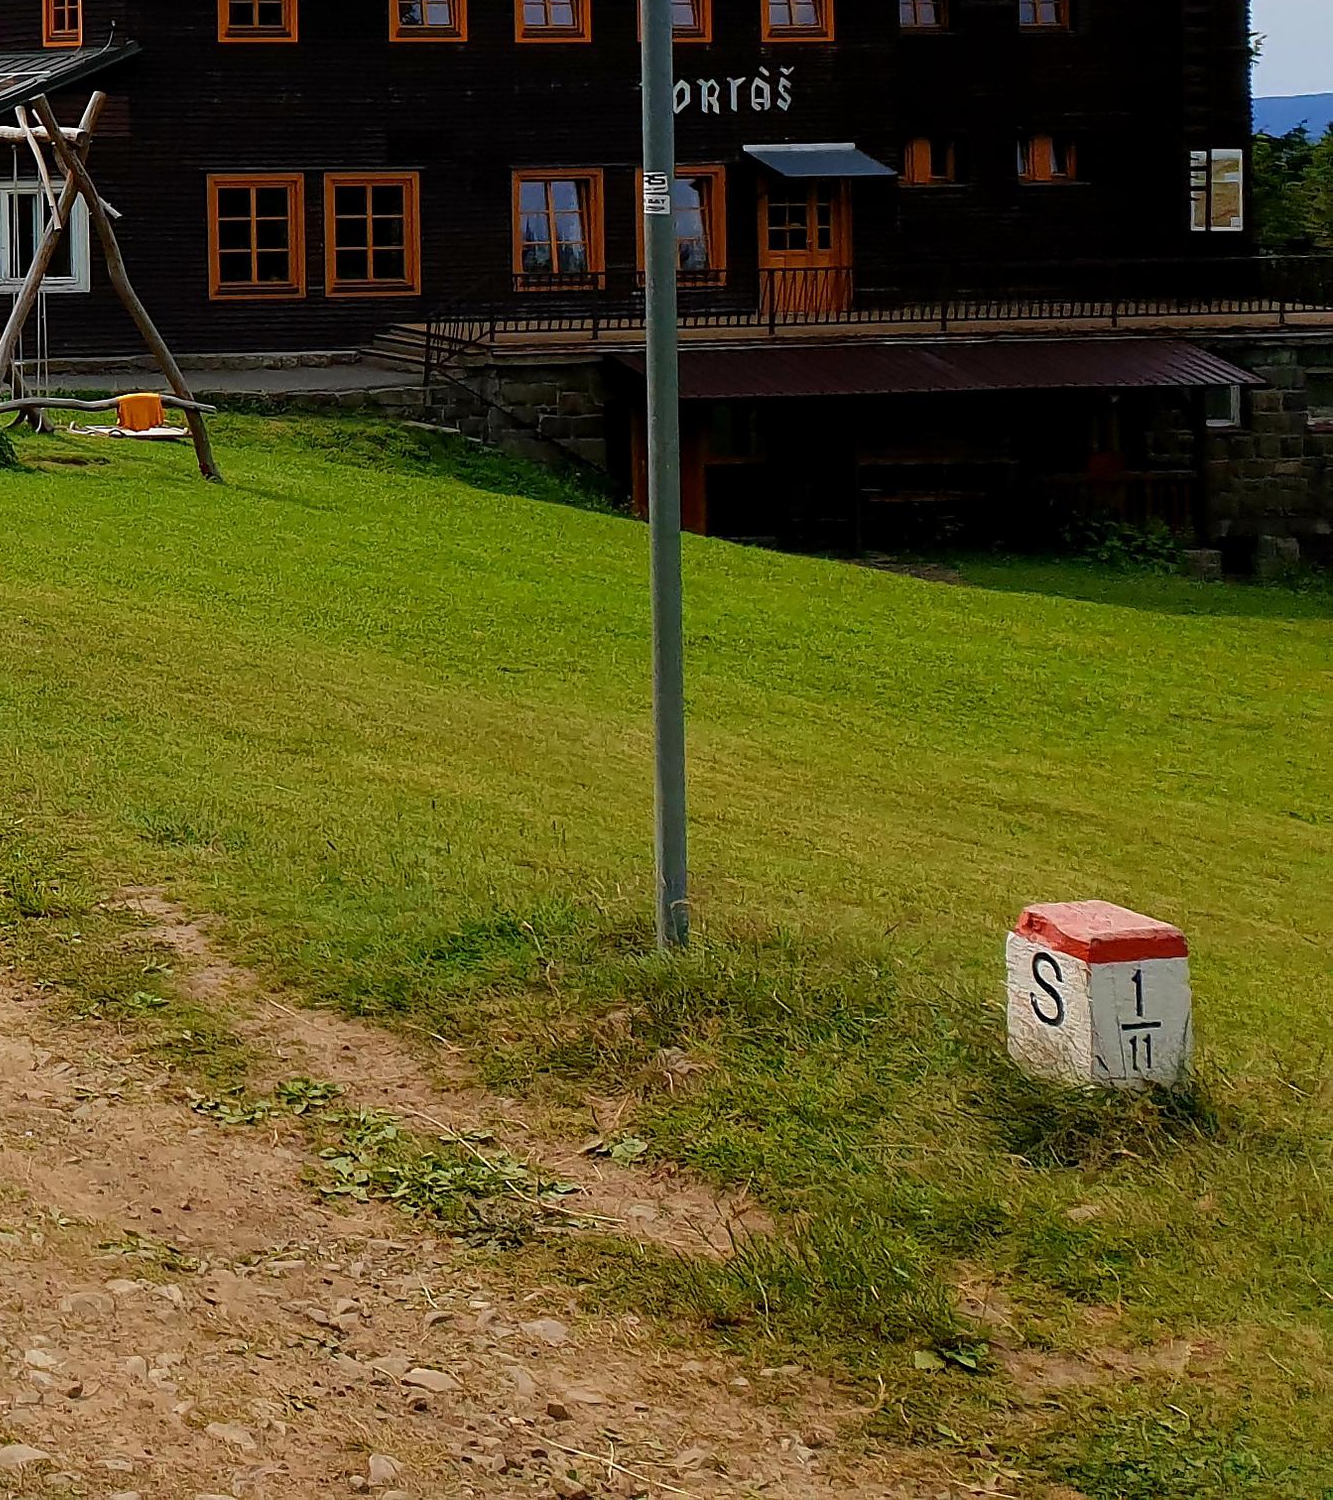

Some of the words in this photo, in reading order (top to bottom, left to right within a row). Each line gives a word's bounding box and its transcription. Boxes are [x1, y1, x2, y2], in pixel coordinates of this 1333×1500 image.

[1030, 952, 1064, 1027] S
[1132, 969, 1143, 1016] 1
[1130, 1034, 1151, 1071] 11
